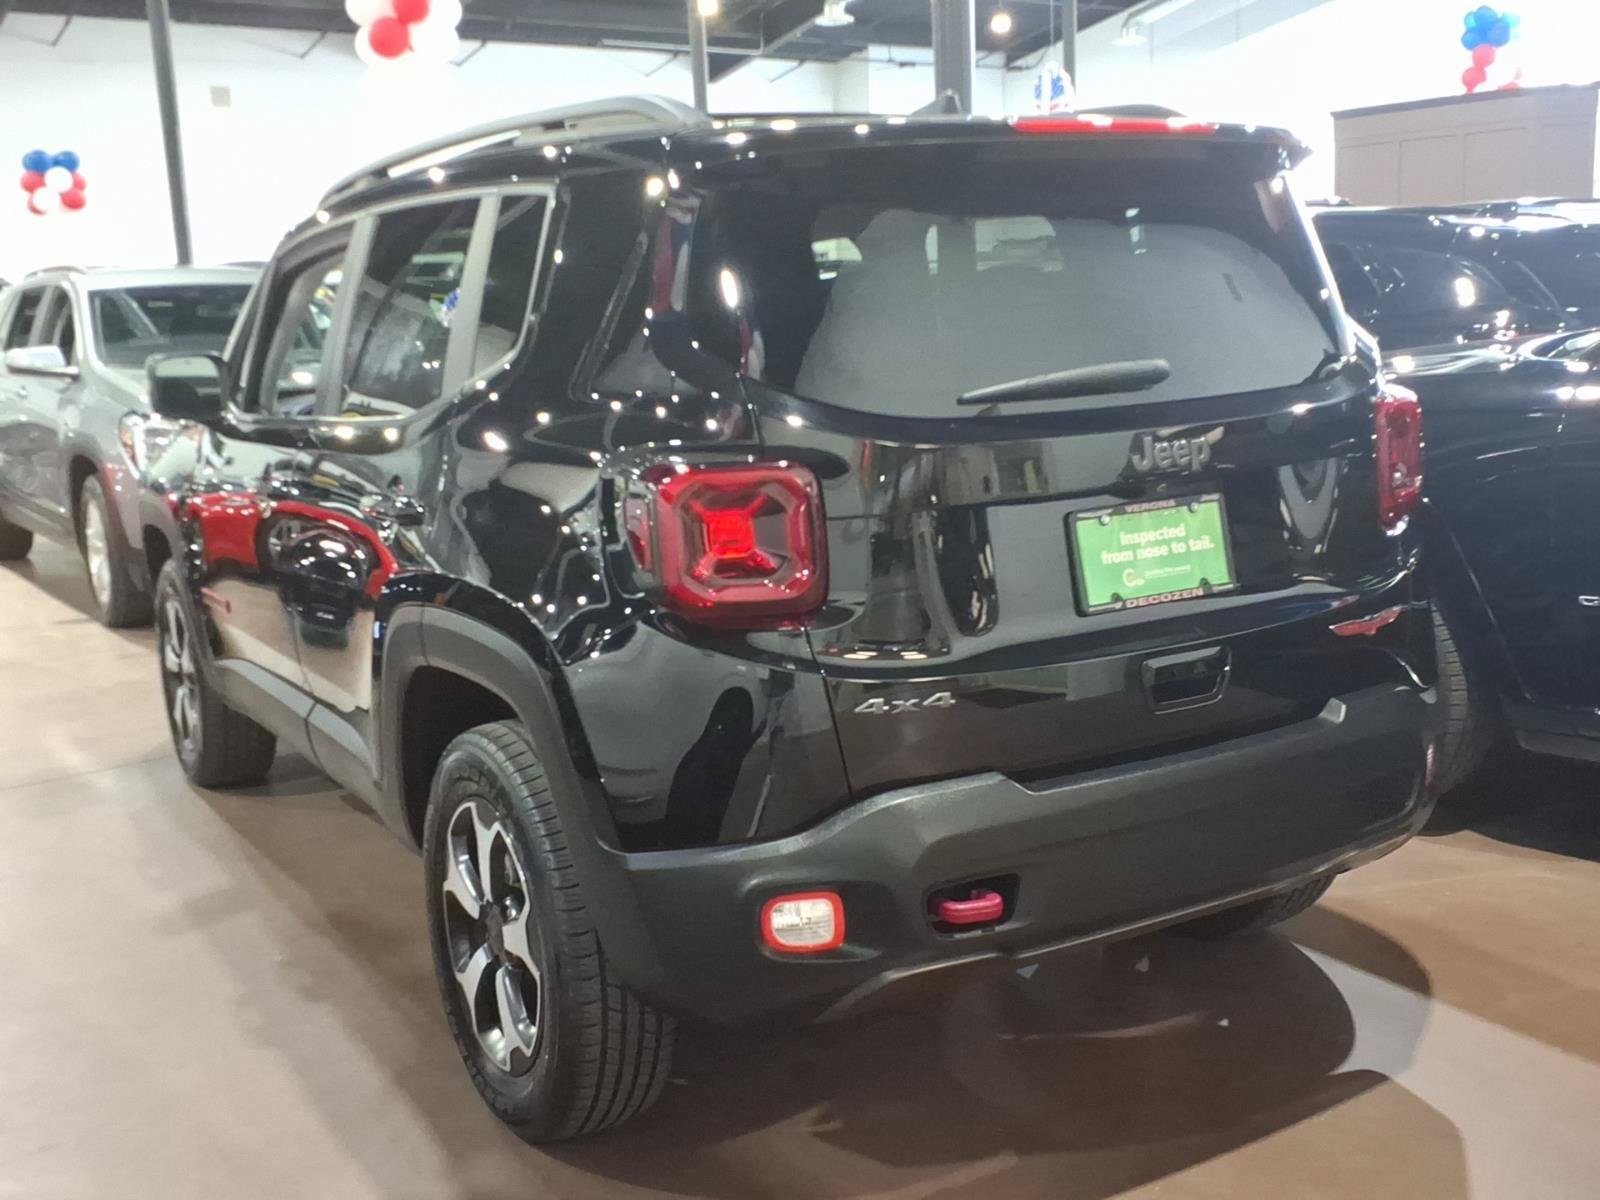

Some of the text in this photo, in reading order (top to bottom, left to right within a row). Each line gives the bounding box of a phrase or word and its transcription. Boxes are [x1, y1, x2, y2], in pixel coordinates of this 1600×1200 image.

[1131, 436, 1211, 471] Jeep
[1120, 523, 1186, 547] Inspected
[1101, 550, 1134, 565] from
[1137, 545, 1168, 560] nose
[1172, 541, 1187, 554] to
[854, 692, 956, 714] 4x4
